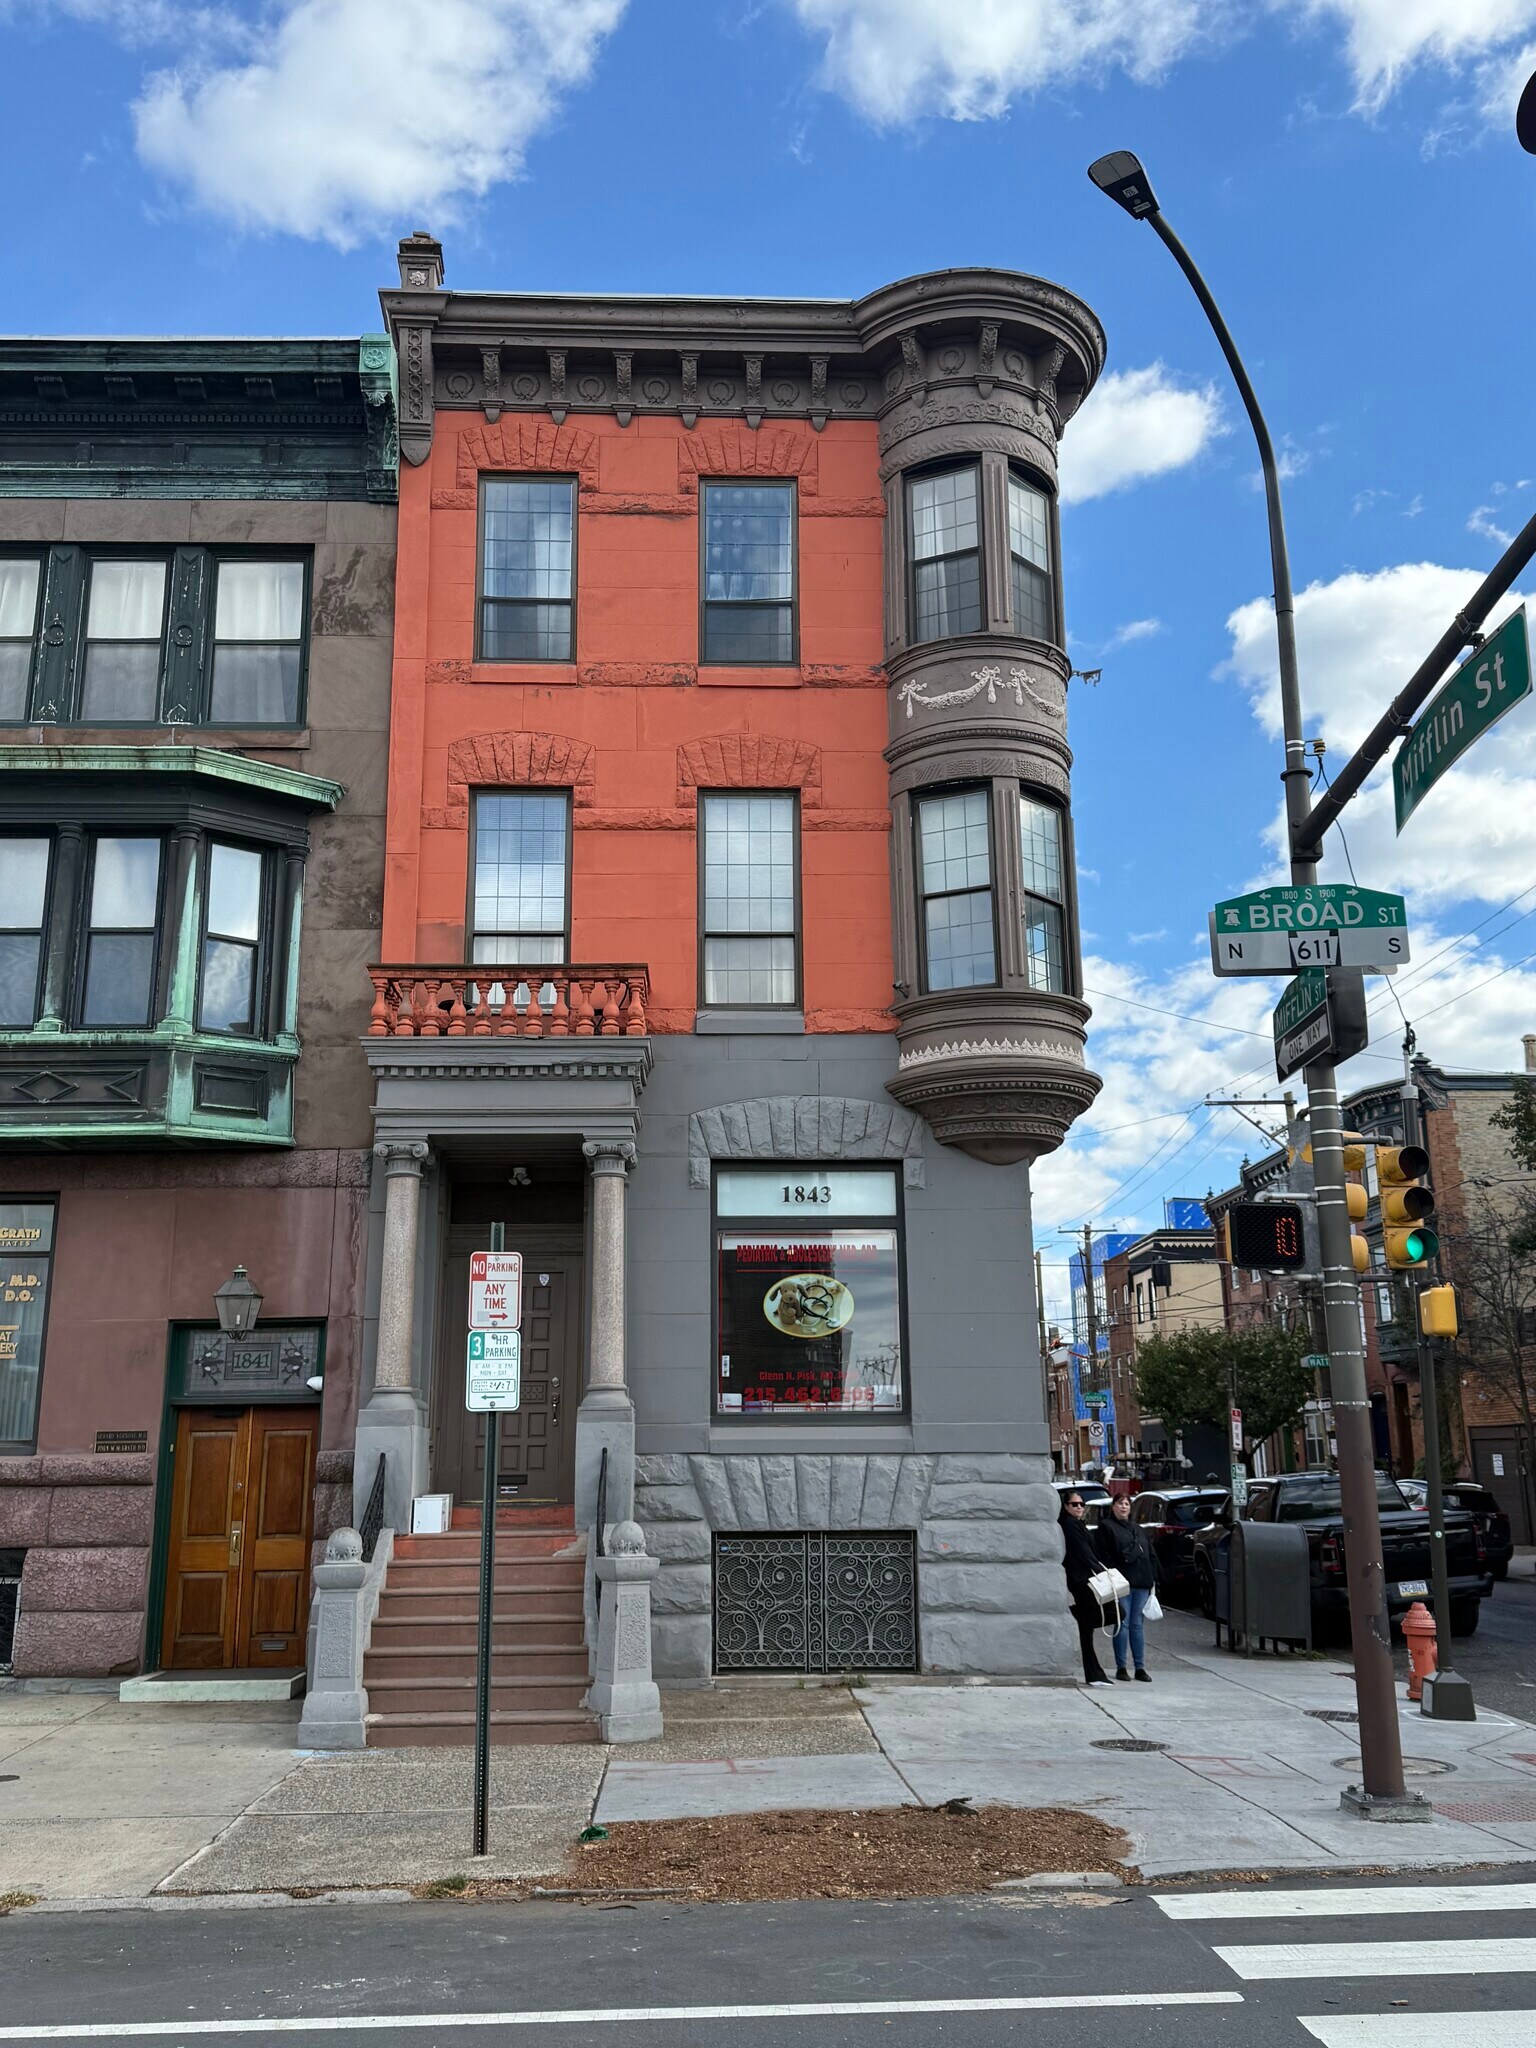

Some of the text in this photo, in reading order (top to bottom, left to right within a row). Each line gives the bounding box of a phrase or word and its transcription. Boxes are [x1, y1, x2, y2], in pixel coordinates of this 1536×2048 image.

[1401, 652, 1507, 799] Mifflin St
[1281, 888, 1336, 900] 1800 S 1900
[1249, 901, 1398, 929] BROAD ST
[1229, 937, 1401, 960] N 611 S
[1275, 984, 1312, 1035] MIFFLIN
[1315, 982, 1322, 1002] ST
[1288, 1021, 1321, 1060] ONE WAY
[782, 1185, 831, 1203] 1843
[736, 1244, 778, 1262] PEDIATRIC
[473, 1260, 518, 1275] NO PARKING
[10, 1274, 41, 1287] M.D.
[485, 1283, 506, 1295] ANY
[4, 1289, 34, 1302] D.O.
[483, 1297, 507, 1309] TIME
[472, 1335, 509, 1356] 3 HR
[485, 1346, 517, 1357] PARKING
[234, 1352, 270, 1369] 1841
